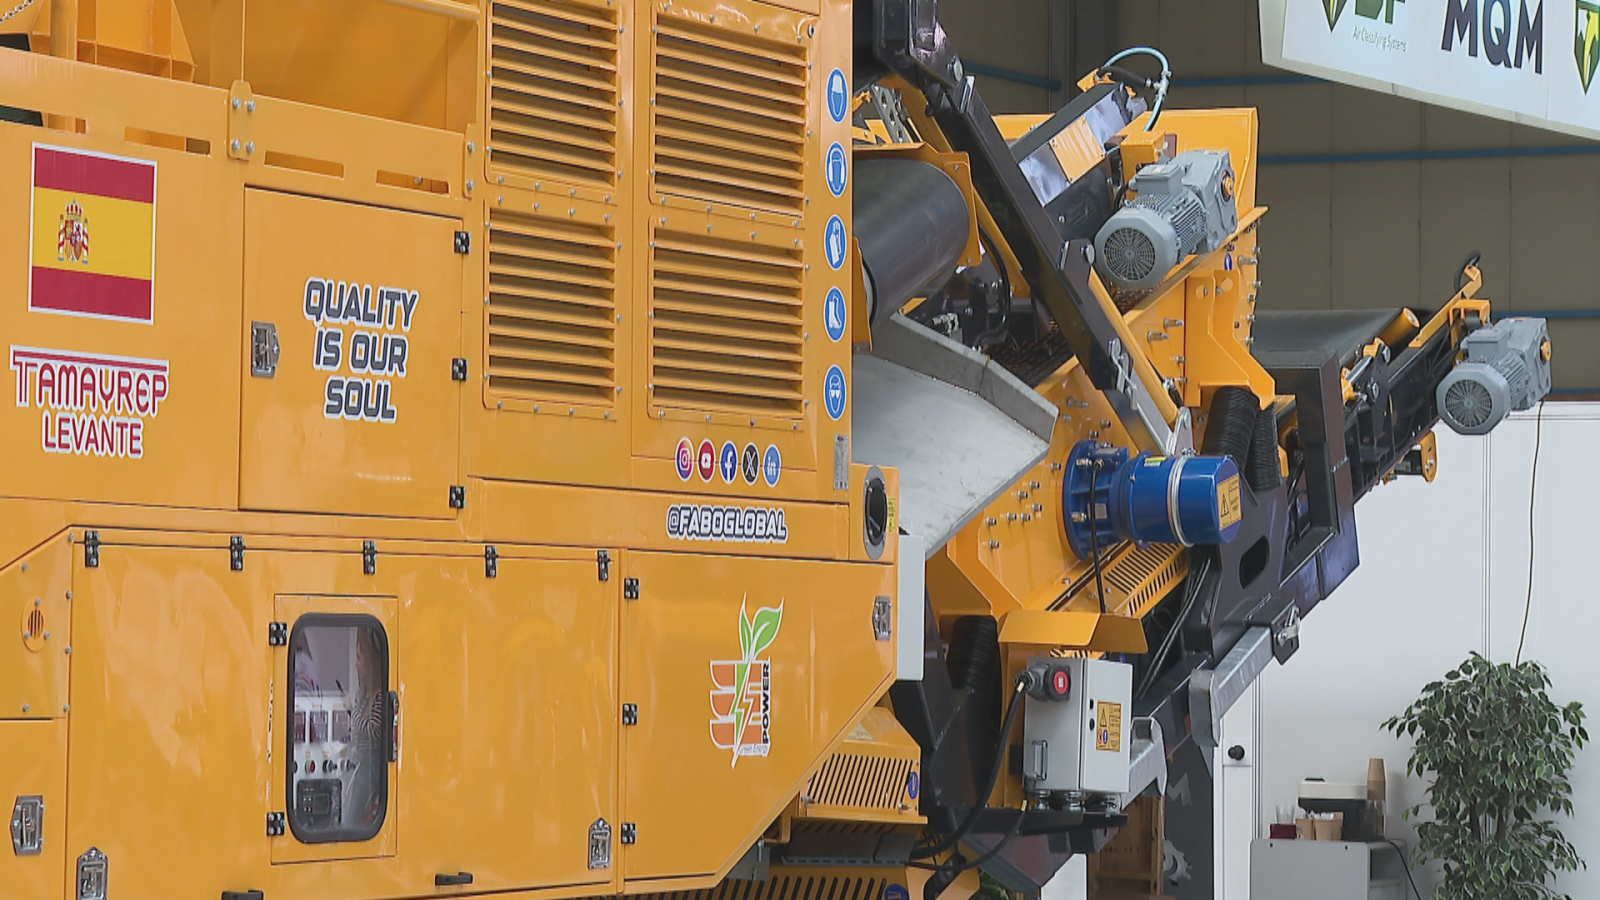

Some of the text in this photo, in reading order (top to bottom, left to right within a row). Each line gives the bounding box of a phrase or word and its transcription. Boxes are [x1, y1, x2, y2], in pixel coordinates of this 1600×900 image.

[1352, 25, 1408, 53] Air Classifying Systems
[1441, 0, 1543, 75] MQM
[304, 280, 418, 328] QUALITY
[314, 329, 408, 374] IS OUR
[11, 347, 168, 416] TAMAYREP
[325, 378, 396, 419] SOUL
[44, 415, 142, 455] LEVANTE
[667, 505, 788, 541] @FABOGLOBAL
[762, 662, 770, 744] POWER
